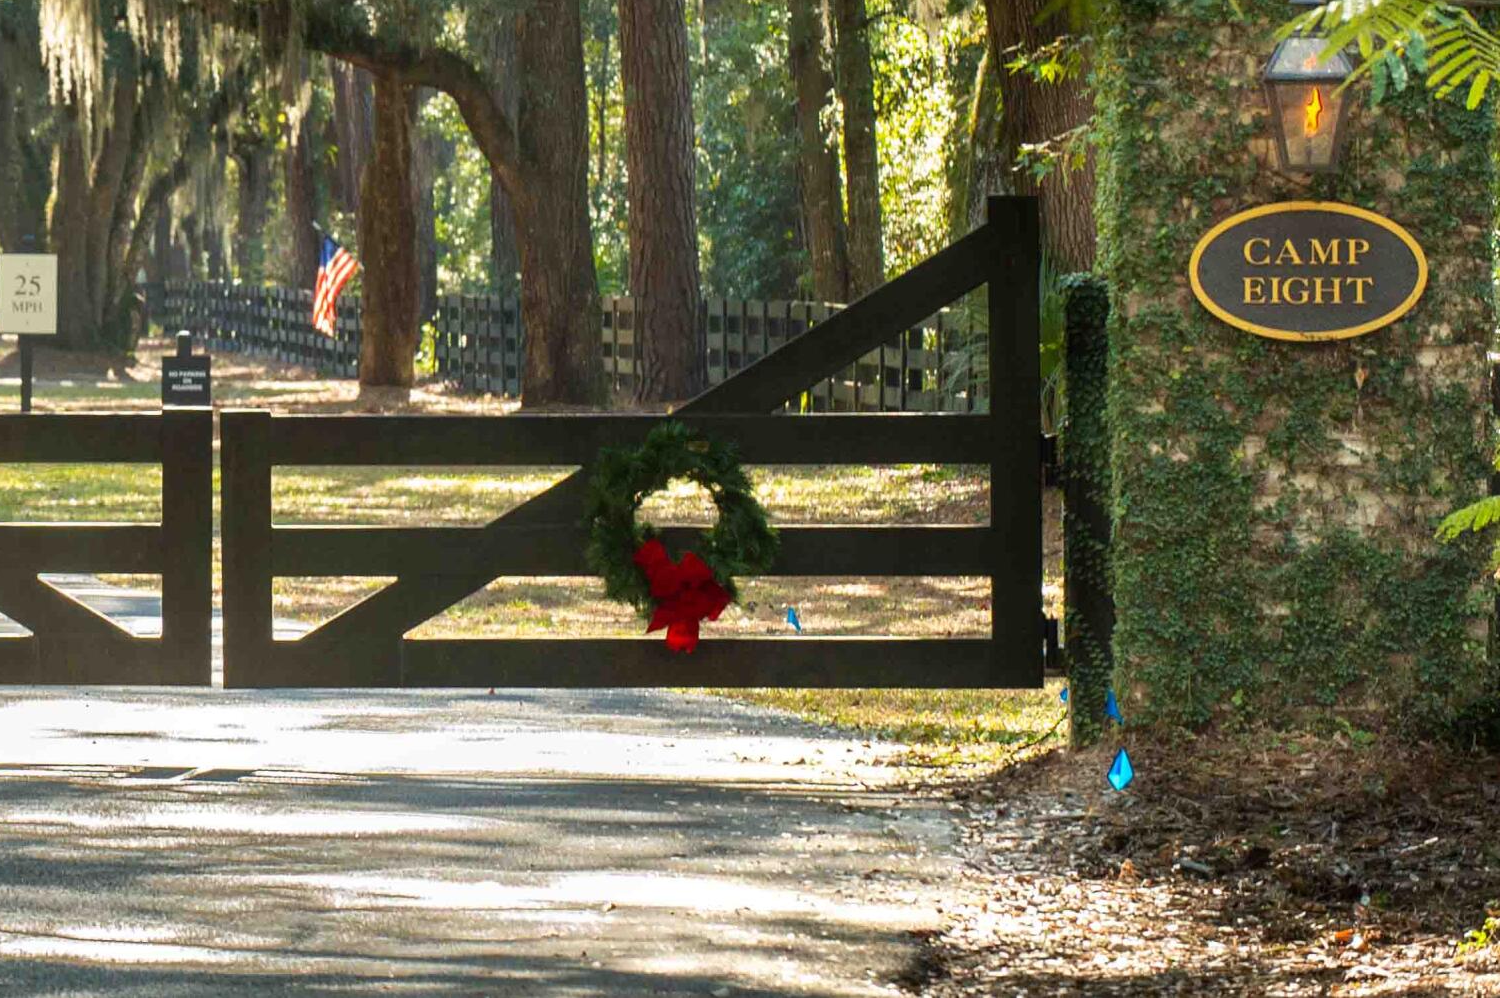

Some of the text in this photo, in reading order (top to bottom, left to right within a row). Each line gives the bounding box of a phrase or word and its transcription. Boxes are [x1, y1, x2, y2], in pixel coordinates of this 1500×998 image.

[1243, 238, 1370, 265] CAMP
[14, 274, 41, 296] 25
[1242, 277, 1373, 305] EIGHT
[12, 301, 43, 314] MPH
